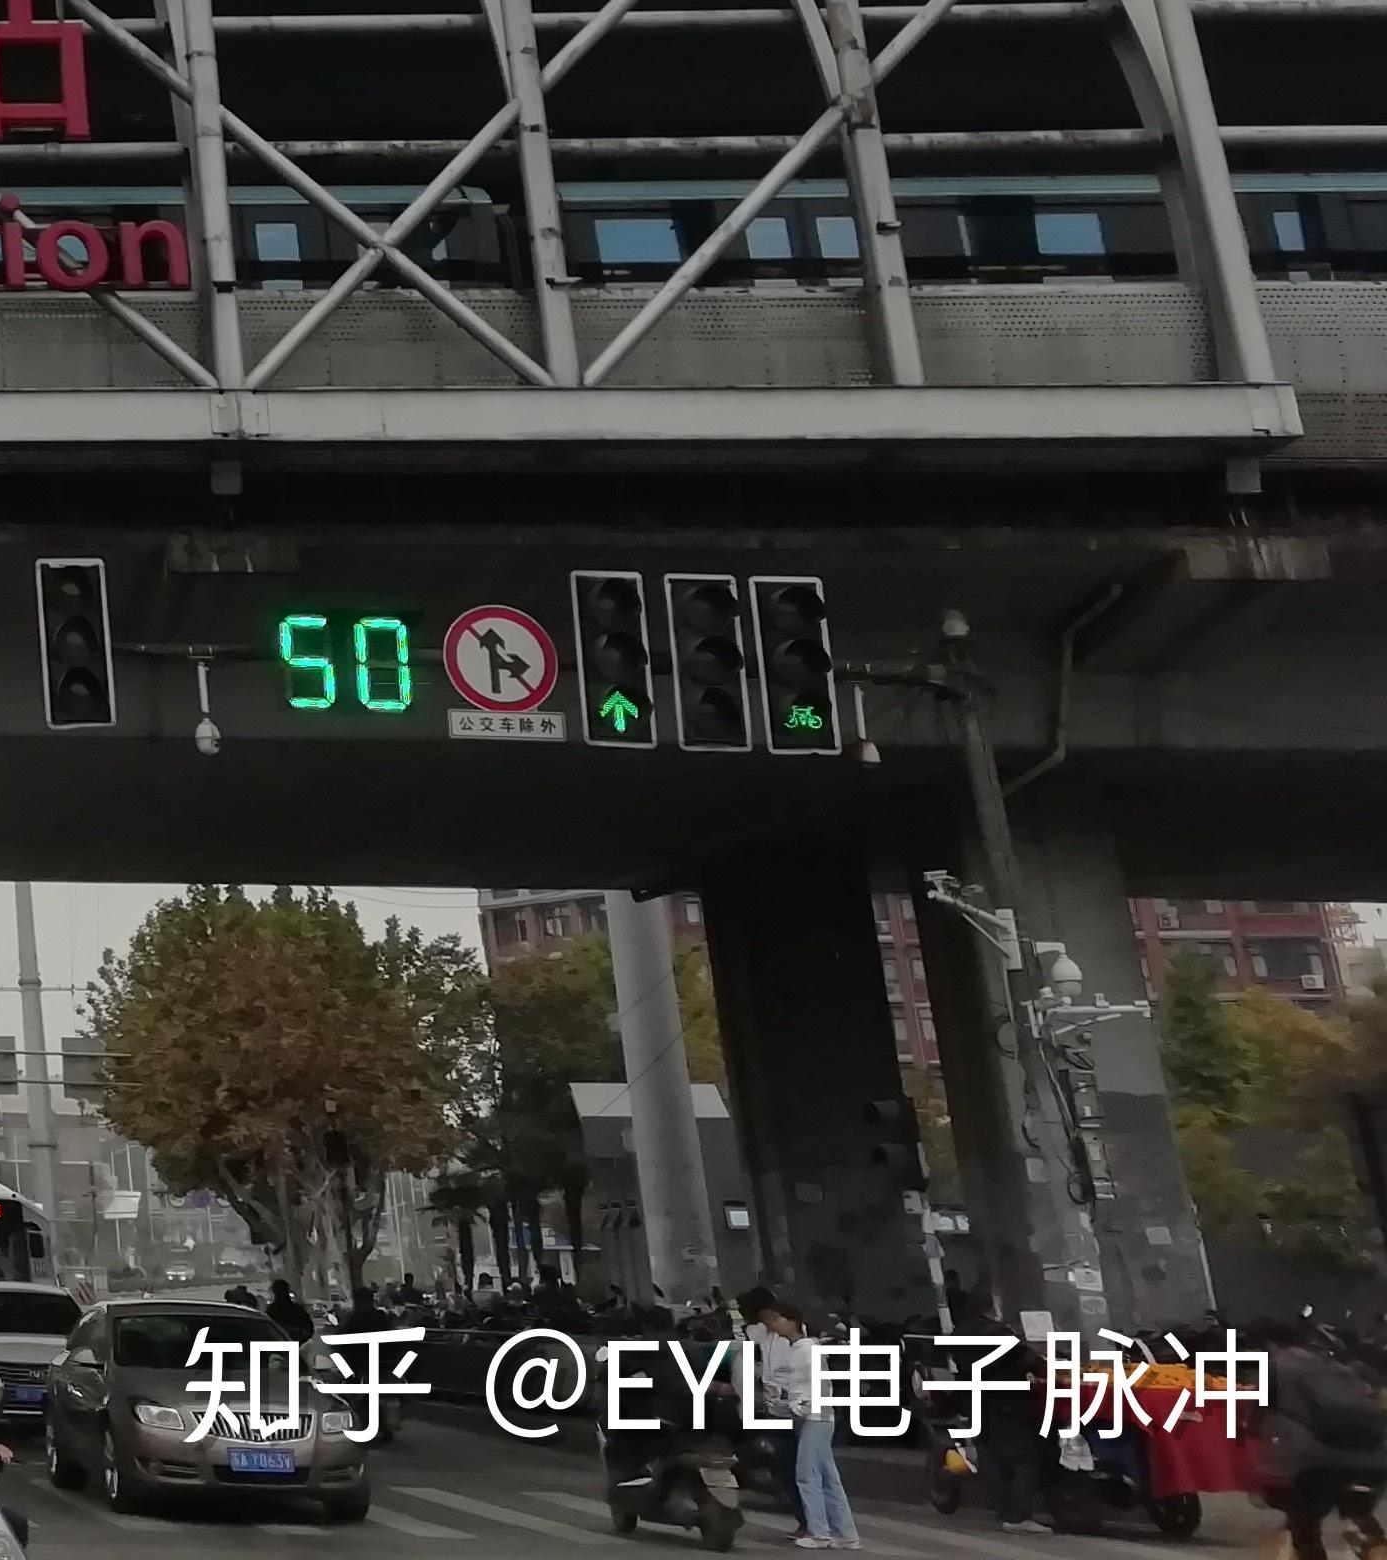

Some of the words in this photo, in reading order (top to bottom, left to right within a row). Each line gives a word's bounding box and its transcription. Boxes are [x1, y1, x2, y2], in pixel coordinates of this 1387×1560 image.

[279, 615, 411, 712] 50
[458, 716, 557, 734] 公交车除外
